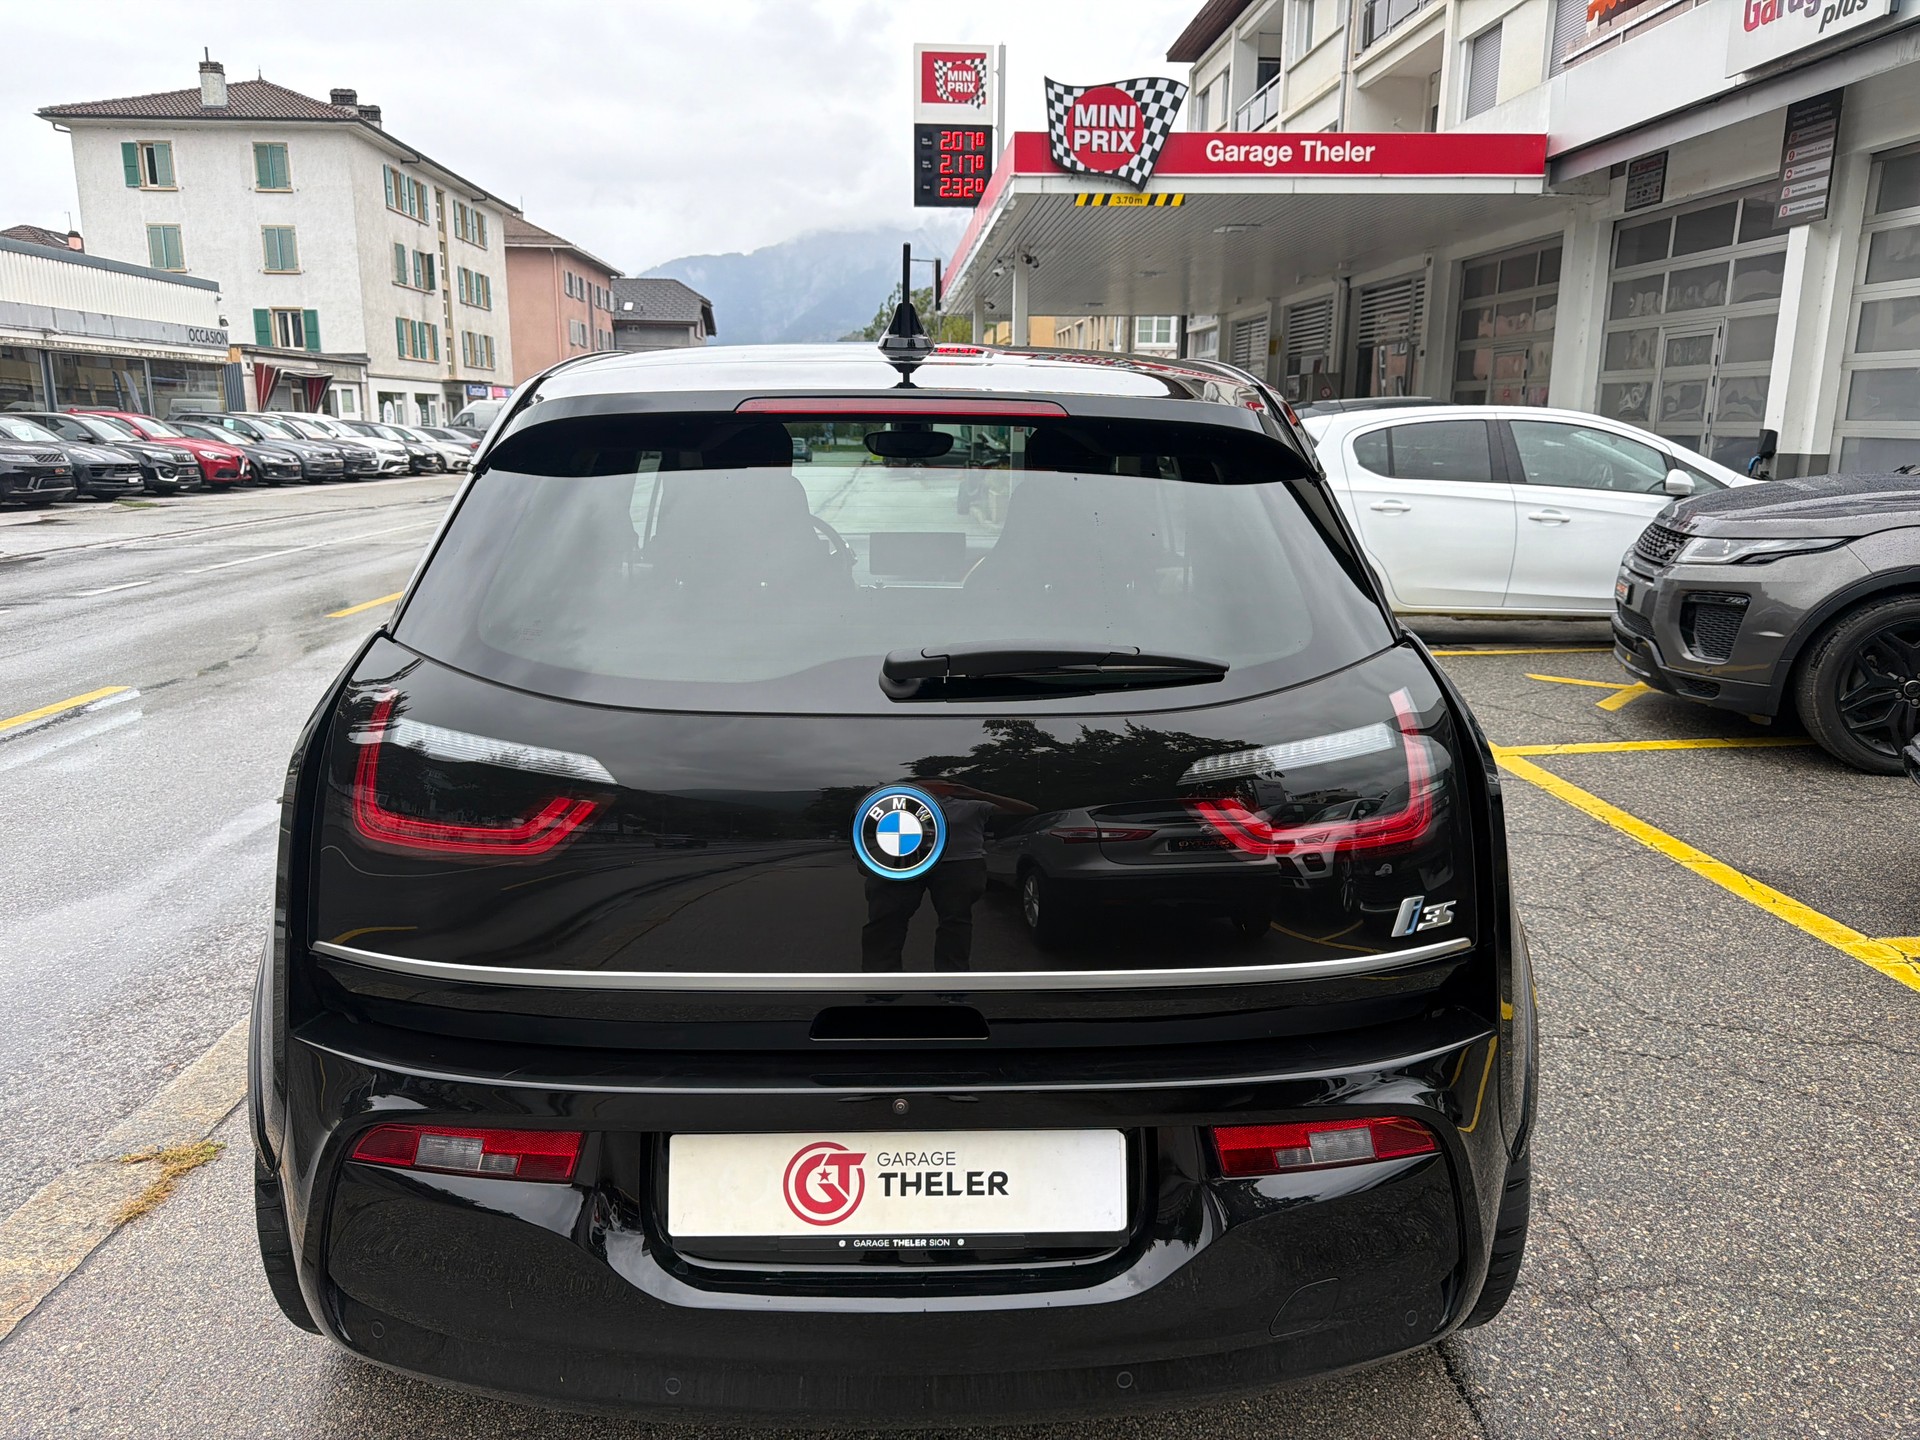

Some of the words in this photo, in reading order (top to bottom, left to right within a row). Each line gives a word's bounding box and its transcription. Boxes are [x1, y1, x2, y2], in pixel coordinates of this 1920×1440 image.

[947, 70, 975, 81] MINI
[947, 82, 976, 93] PRIX
[1074, 104, 1136, 128] MINI
[1073, 130, 1136, 152] PRIX
[1205, 139, 1293, 167] Garage
[1300, 140, 1375, 162] Theler
[188, 328, 228, 345] OCCASION
[869, 797, 931, 822] BMW
[877, 1151, 956, 1167] GARAGE
[877, 1171, 1009, 1197] THELER
[853, 1239, 890, 1248] GARAGE
[892, 1239, 927, 1247] THELER
[929, 1238, 951, 1247] SION
